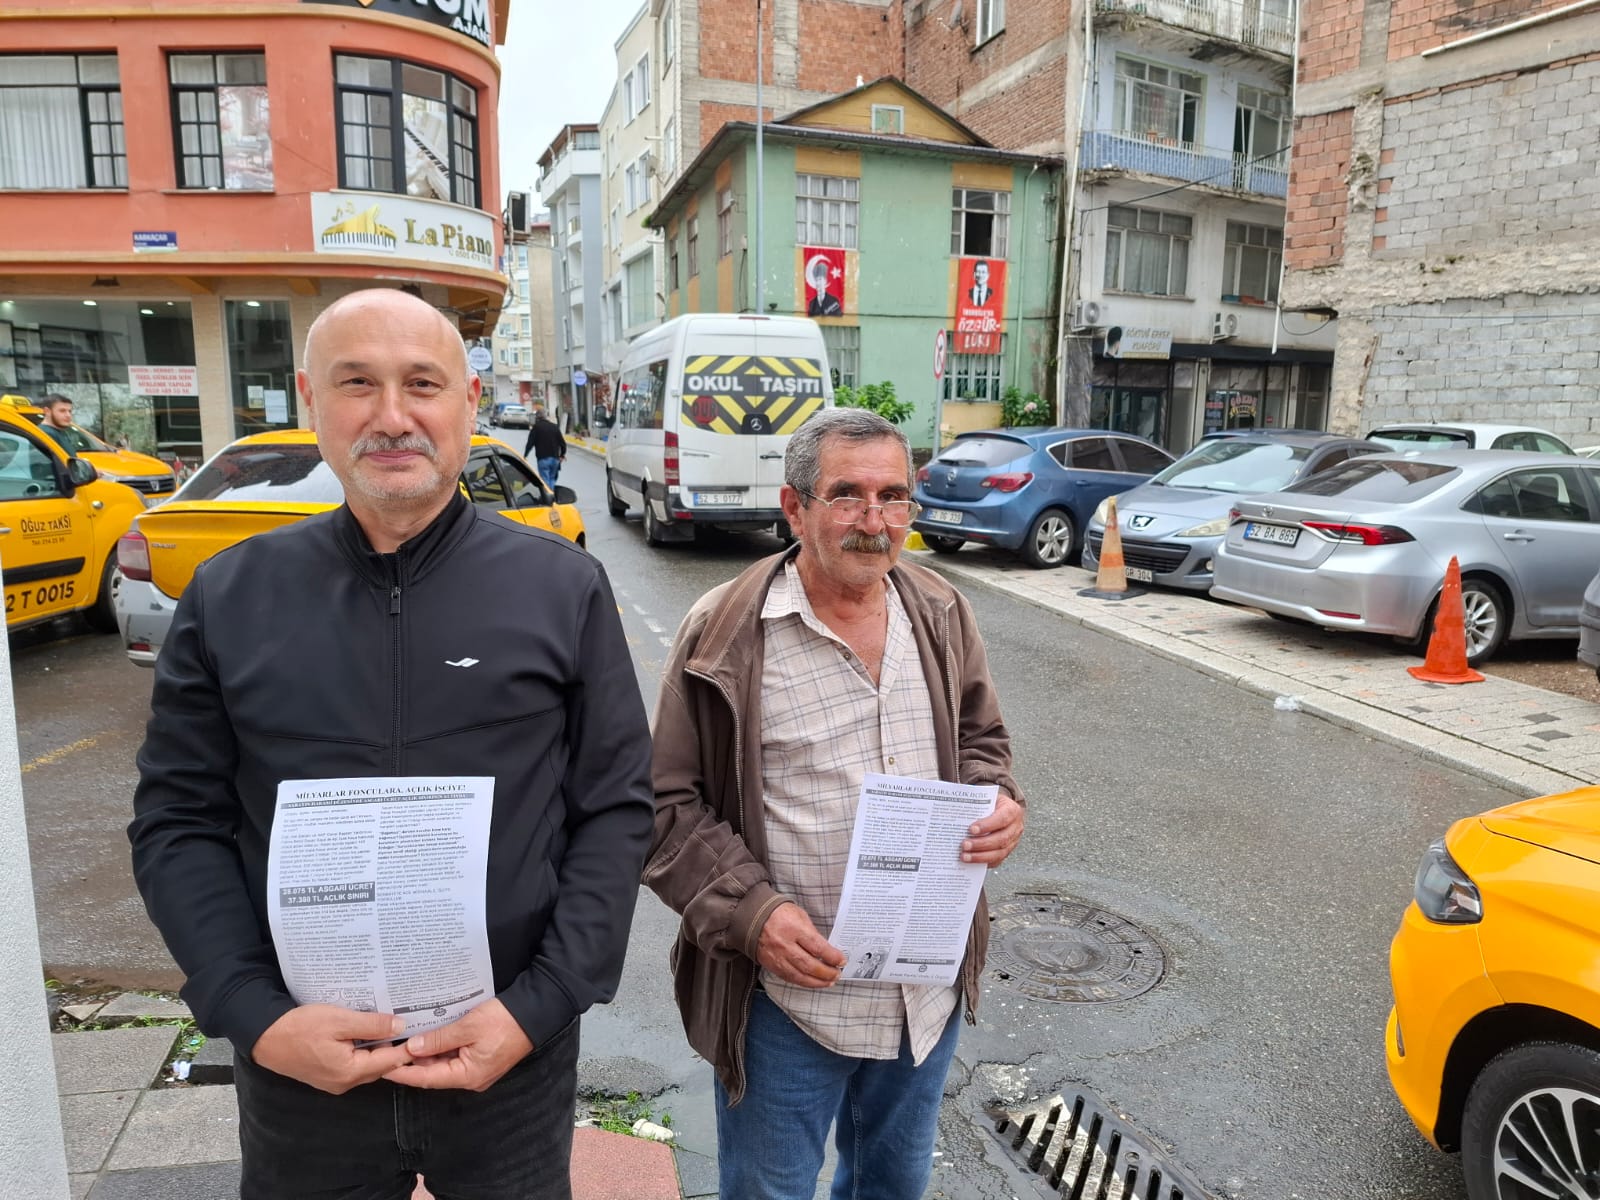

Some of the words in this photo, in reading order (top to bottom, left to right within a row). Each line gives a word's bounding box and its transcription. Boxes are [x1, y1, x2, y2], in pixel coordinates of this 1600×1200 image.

[404, 218, 438, 246] La
[441, 223, 492, 257] Piano
[688, 375, 744, 392] OKUL
[760, 376, 820, 397] TAŞITI
[20, 516, 46, 533] OĞUZ
[47, 513, 72, 531] TAKSİ
[1249, 524, 1261, 537] 52
[1263, 527, 1276, 540] BA
[21, 590, 32, 609] T
[36, 580, 74, 605] 0015
[308, 886, 316, 894] TL
[318, 883, 347, 893] ASGARİ
[348, 882, 374, 891] ÜCRET
[313, 895, 321, 903] TL
[323, 893, 346, 902] AÇLIK
[347, 892, 369, 900] SINIRI
